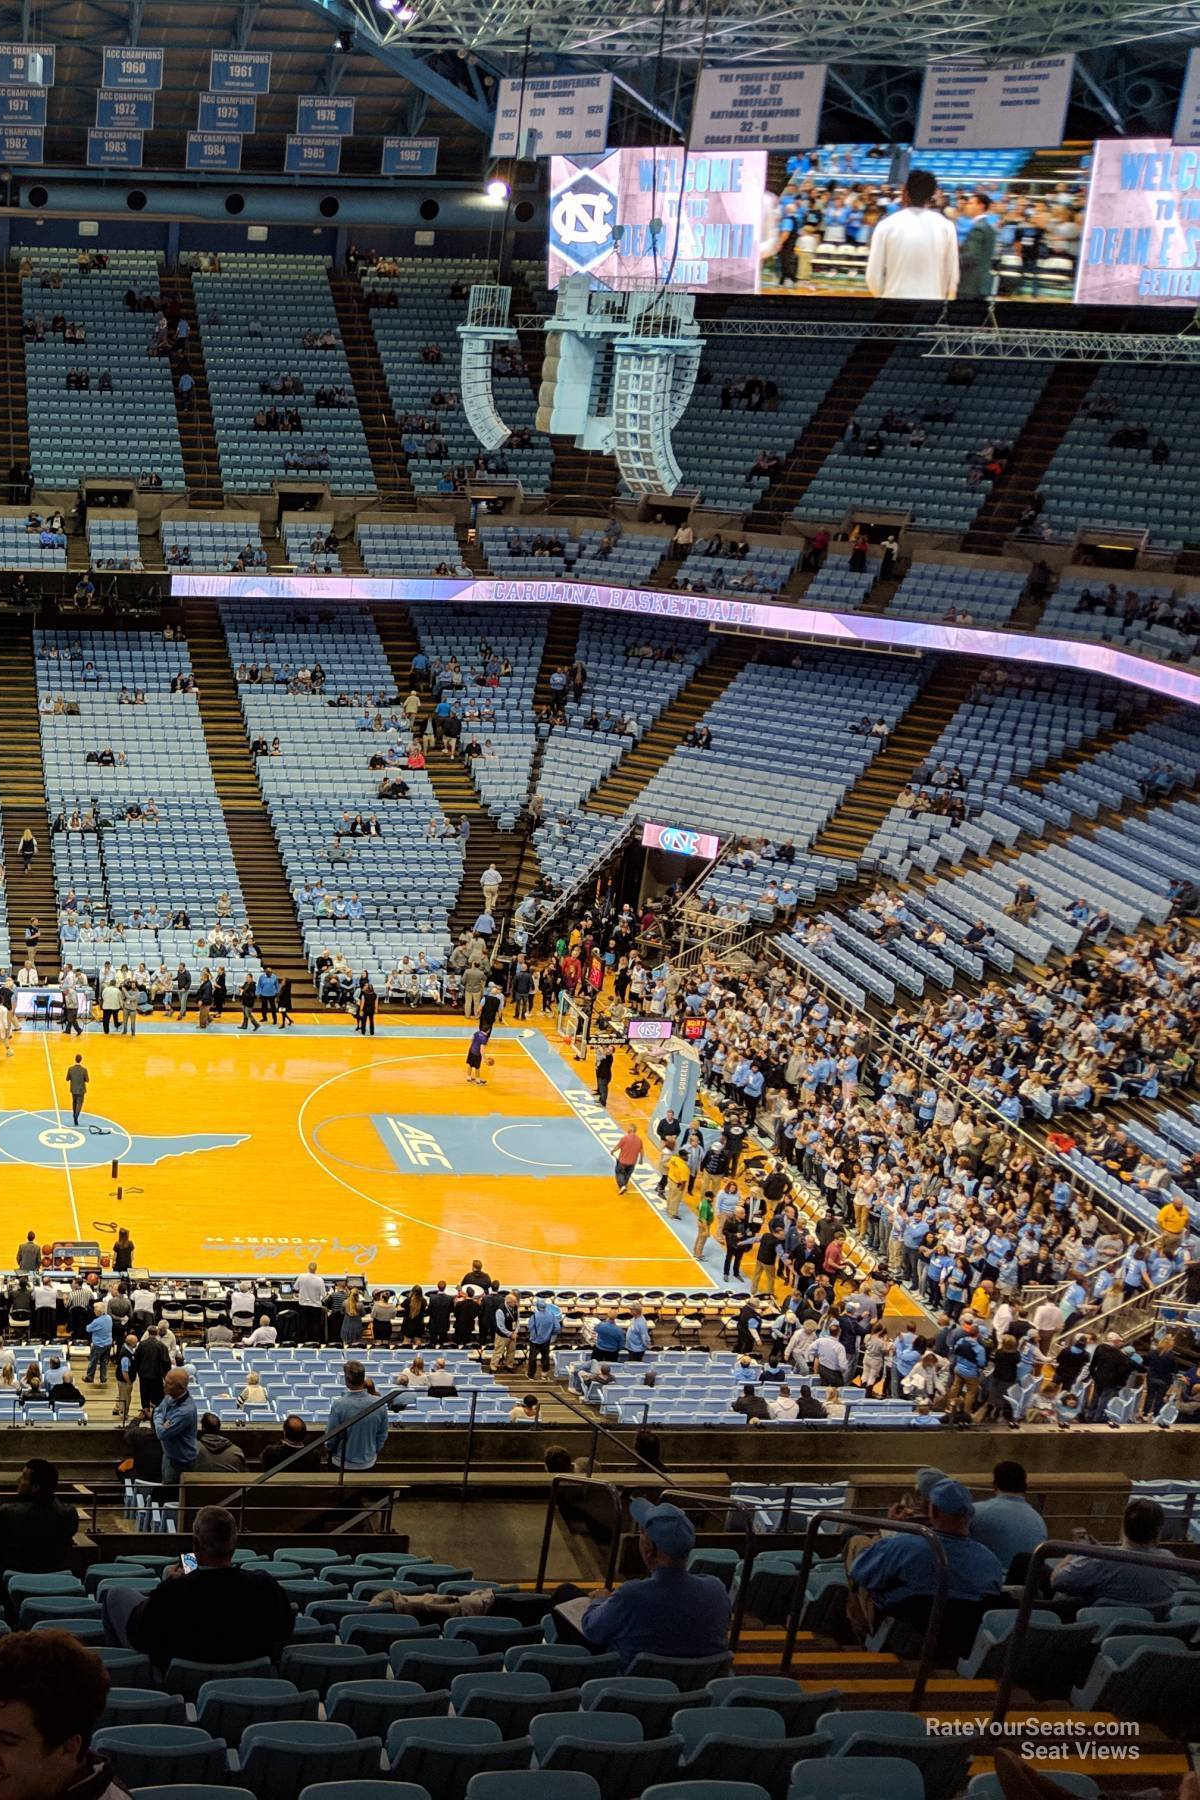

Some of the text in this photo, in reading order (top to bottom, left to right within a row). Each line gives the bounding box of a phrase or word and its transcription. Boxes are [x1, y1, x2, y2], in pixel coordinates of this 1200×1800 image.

[12, 46, 53, 55] CHAMPIONS
[106, 50, 161, 59] ACC CHAMPIONS
[214, 53, 269, 63] ACC CHAMPIONS
[121, 62, 146, 74] 1960
[230, 66, 252, 77] 1961
[720, 71, 804, 82] THE PERFECT SEASON
[511, 77, 600, 91] SOUTHERN CONFERENCE
[7, 88, 45, 97] CHAMPIONS
[114, 92, 152, 101] CHAMPIONS
[8, 100, 28, 111] 1971
[216, 96, 255, 104] CHAMPIONS
[315, 100, 353, 108] CHAMPIONS
[732, 98, 783, 107] UNDEFEATED
[115, 104, 136, 114] 1972
[217, 107, 238, 118] 1975
[710, 108, 800, 119] NATIONAL CHAMPIONS
[316, 110, 336, 121] 1976
[4, 128, 42, 136] CHAMPIONS
[740, 122, 753, 132] 32
[90, 130, 141, 140] ACC CHAMPIONS
[190, 133, 240, 143] ACC CHAMPIONS
[704, 136, 731, 144] COACH
[733, 135, 760, 144] FRANK
[400, 150, 421, 161] 1987
[638, 158, 744, 193] WELCOME
[1120, 152, 1200, 192] WELC
[688, 199, 709, 218] THE
[1156, 199, 1176, 220] TO
[694, 224, 754, 259] SMITH
[1088, 227, 1152, 265] DEAN
[1159, 227, 1176, 267] E
[494, 582, 754, 623] CAROLINA BASKETBALL
[394, 1119, 454, 1170] ACC
